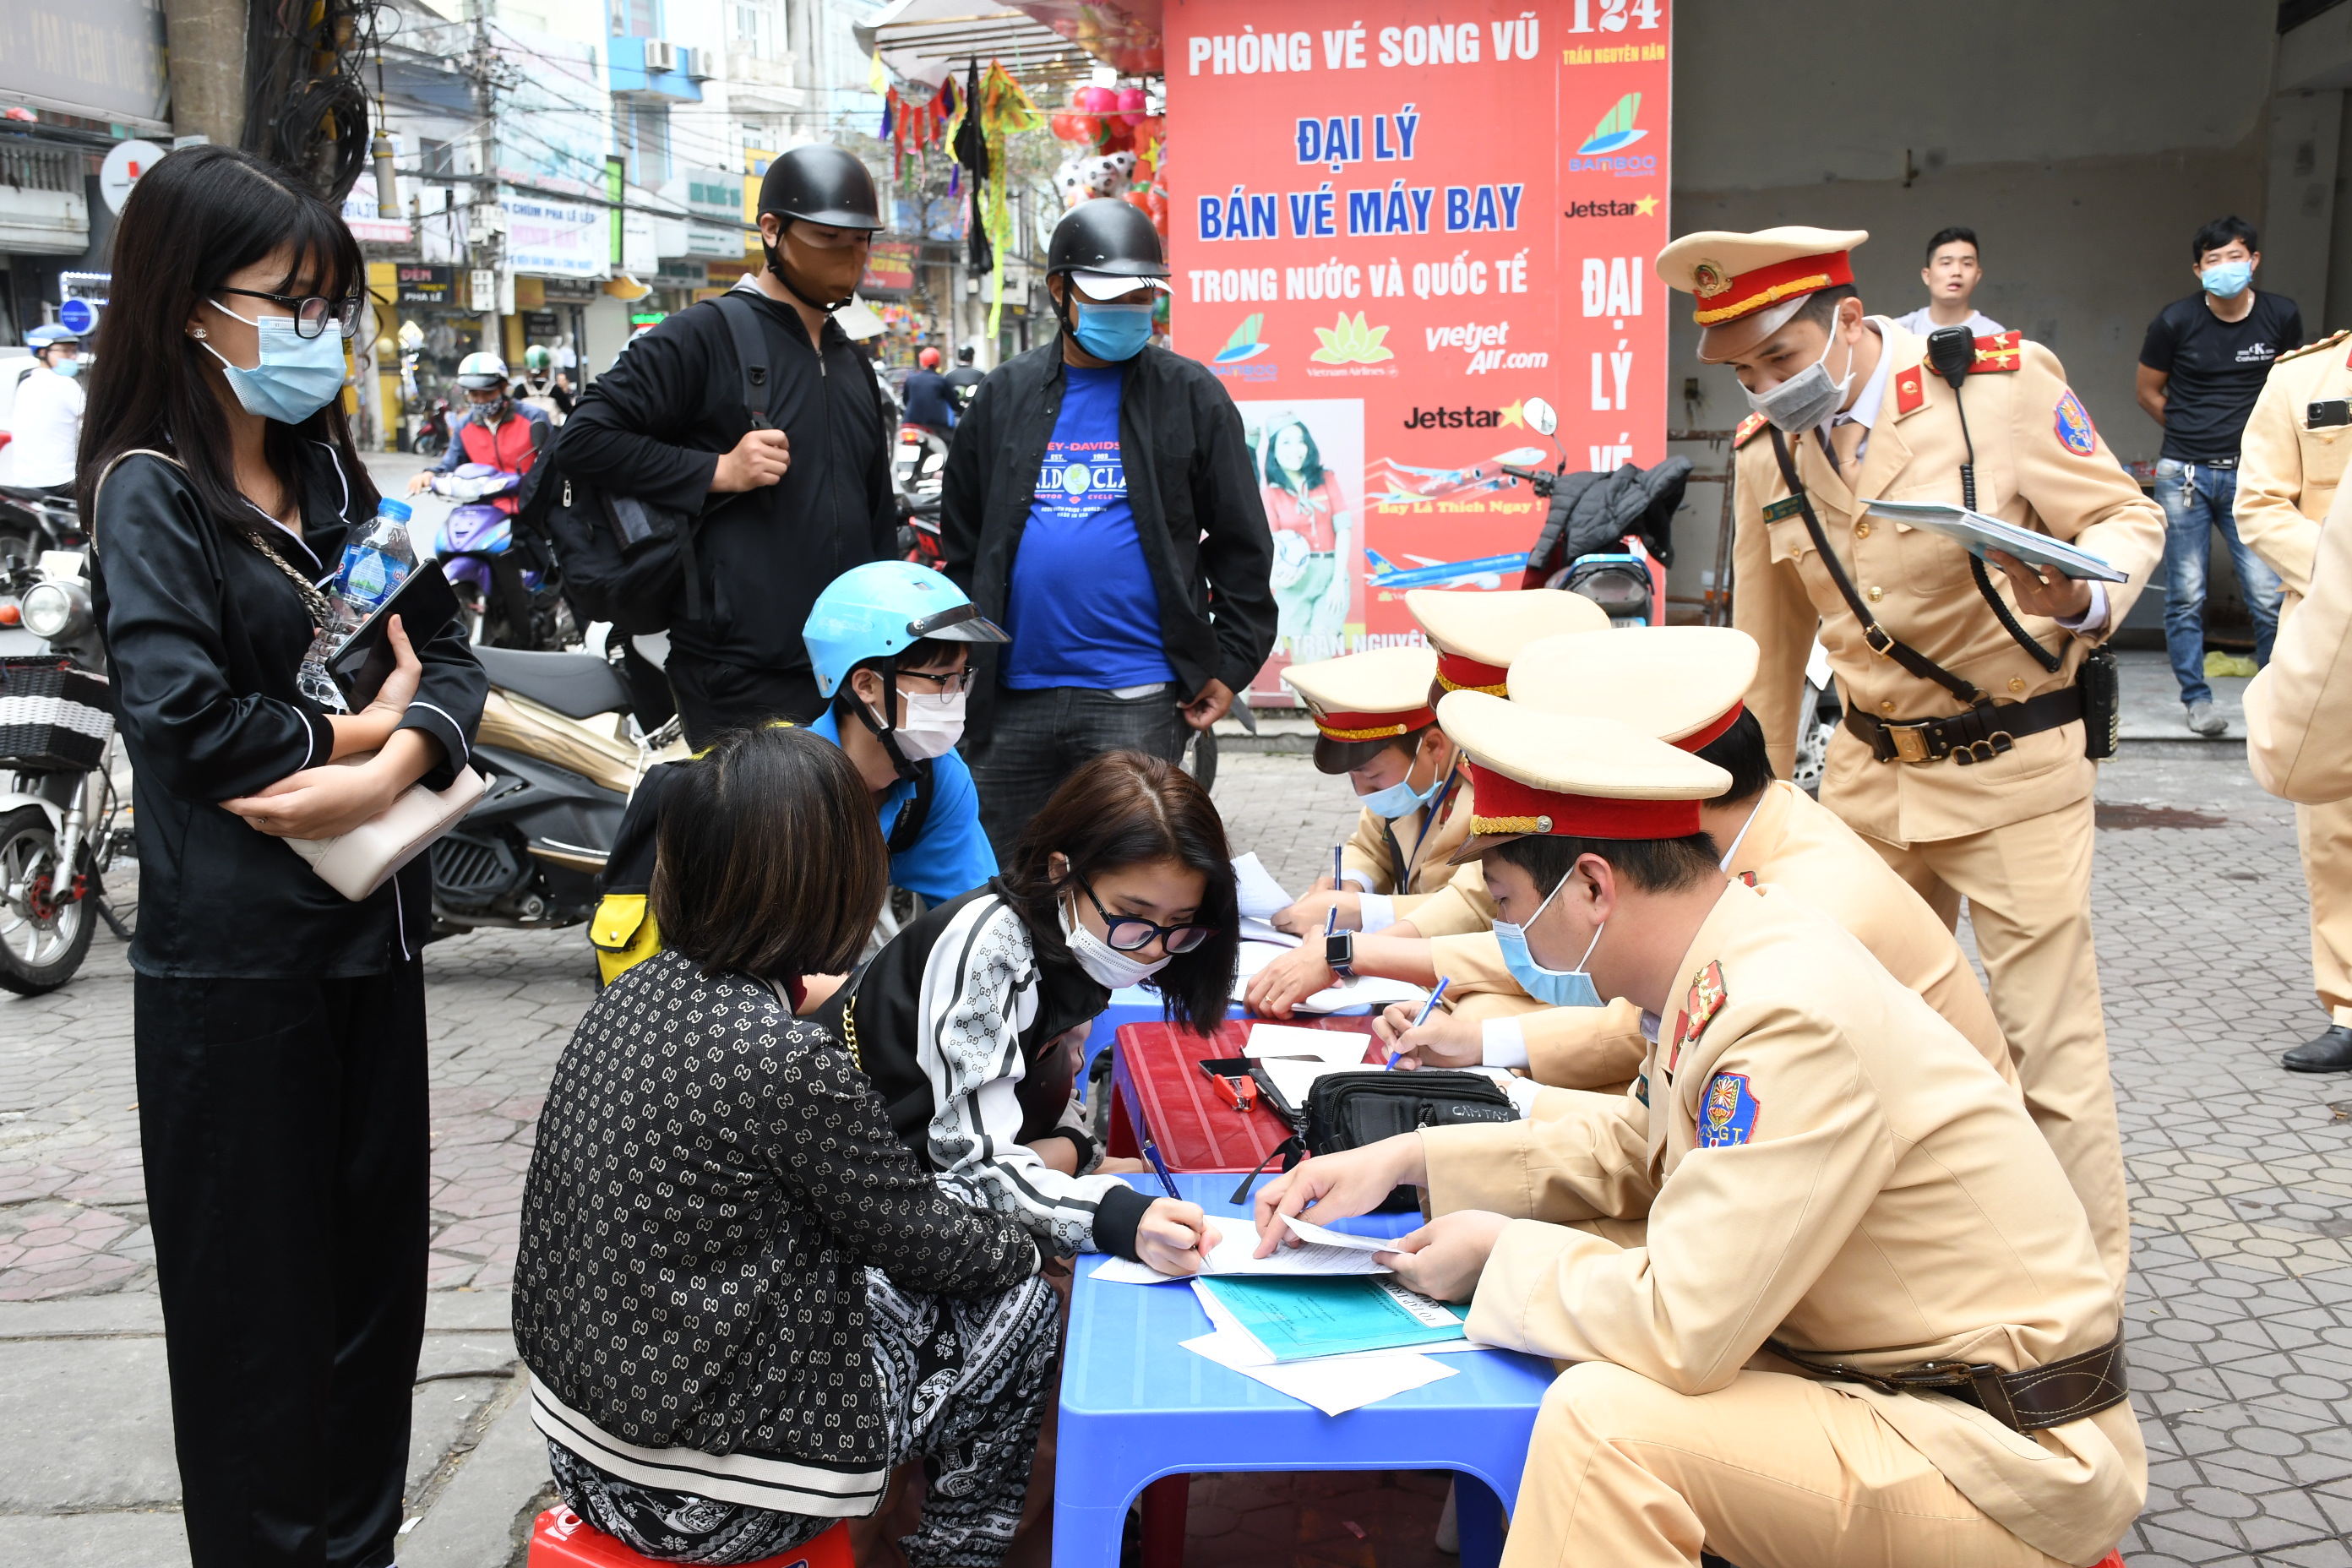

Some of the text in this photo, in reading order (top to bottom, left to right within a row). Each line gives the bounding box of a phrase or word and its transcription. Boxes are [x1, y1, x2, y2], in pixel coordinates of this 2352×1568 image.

[1189, 12, 1538, 76] PHÒNG VÉ SONG VŨ
[1295, 103, 1420, 173] ĐẠI LÝ
[1569, 155, 1657, 172] BAMBOO
[1198, 179, 1524, 242] BÁN VÉ MÁY BAY
[1565, 200, 1637, 218] Jetstar
[1189, 248, 1530, 302] TRONG NƯỚC VÀ QUỐC TẾ
[1581, 257, 1642, 330] ĐẠI
[1306, 366, 1386, 378] Vietnam Airlines
[1591, 339, 1632, 411] LÝ
[1404, 406, 1503, 429] Jetstar
[1489, 500, 1533, 514] Ngay
